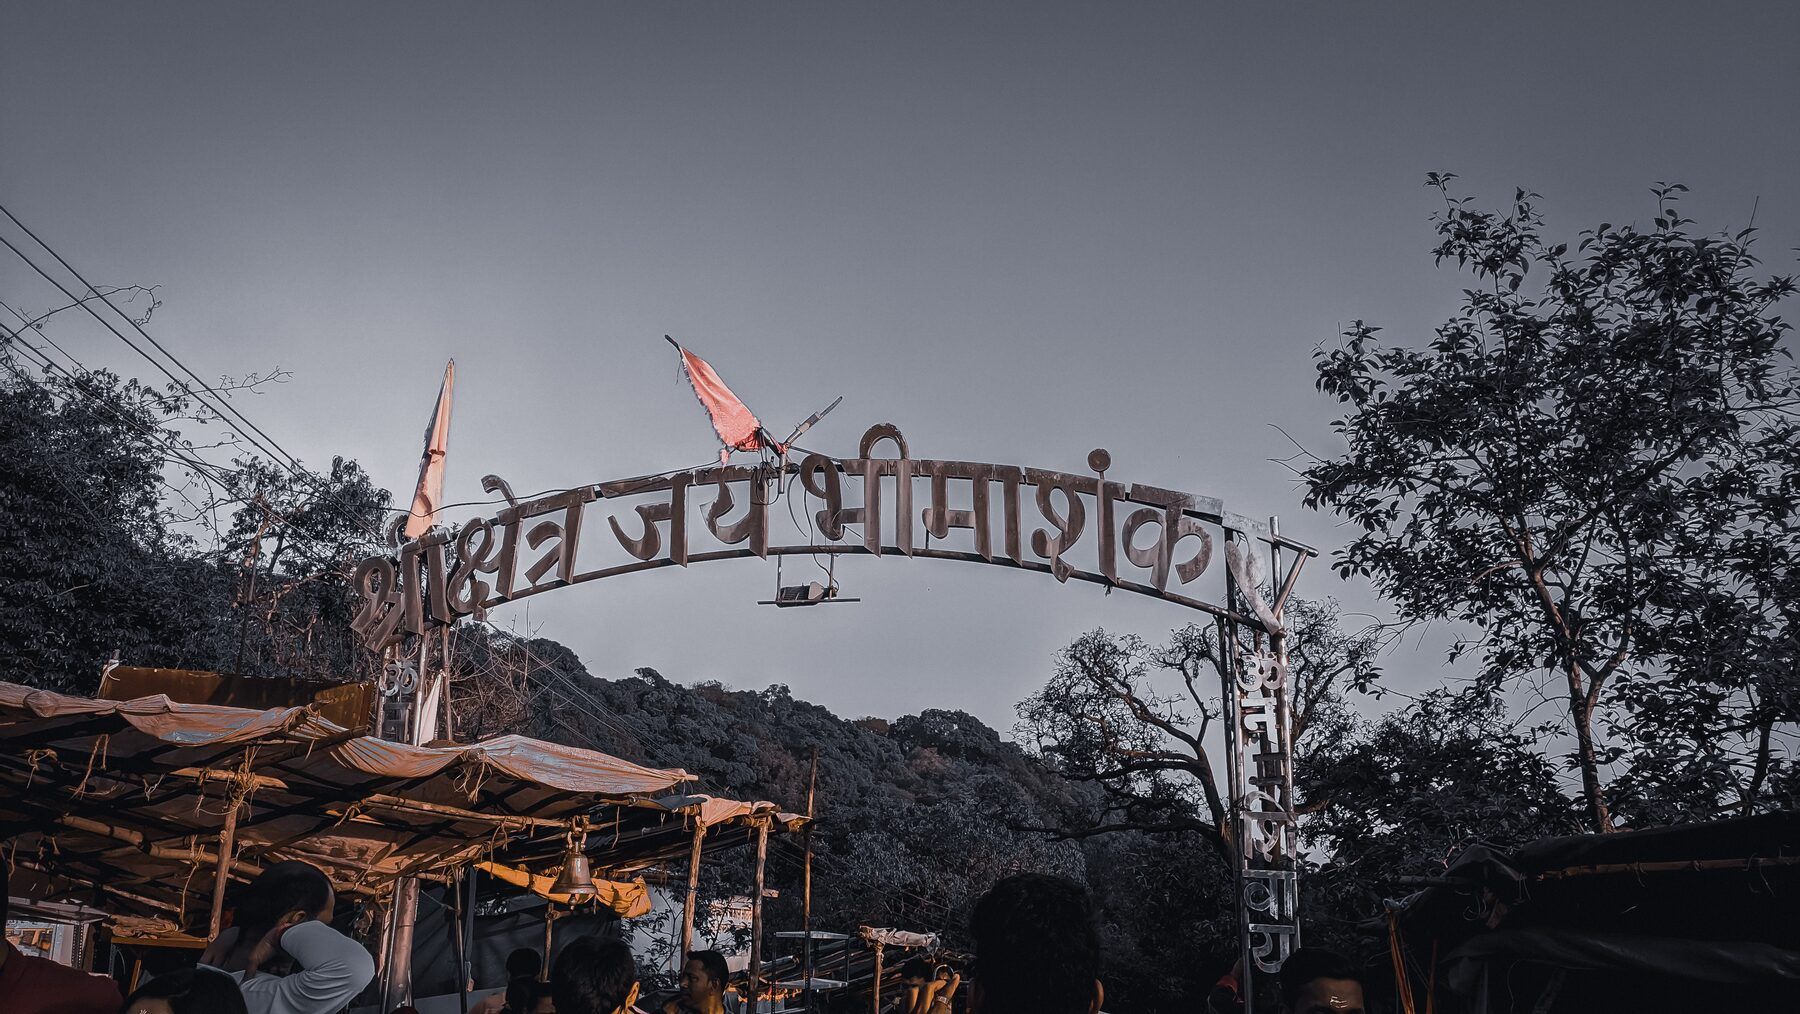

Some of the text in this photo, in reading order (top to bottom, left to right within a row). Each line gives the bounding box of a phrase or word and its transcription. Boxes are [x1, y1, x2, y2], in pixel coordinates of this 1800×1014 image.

[350, 512, 450, 652] श्री
[448, 474, 597, 622] क्षेत्र
[599, 464, 780, 568] जय
[1242, 791, 1298, 974] शिवाय
